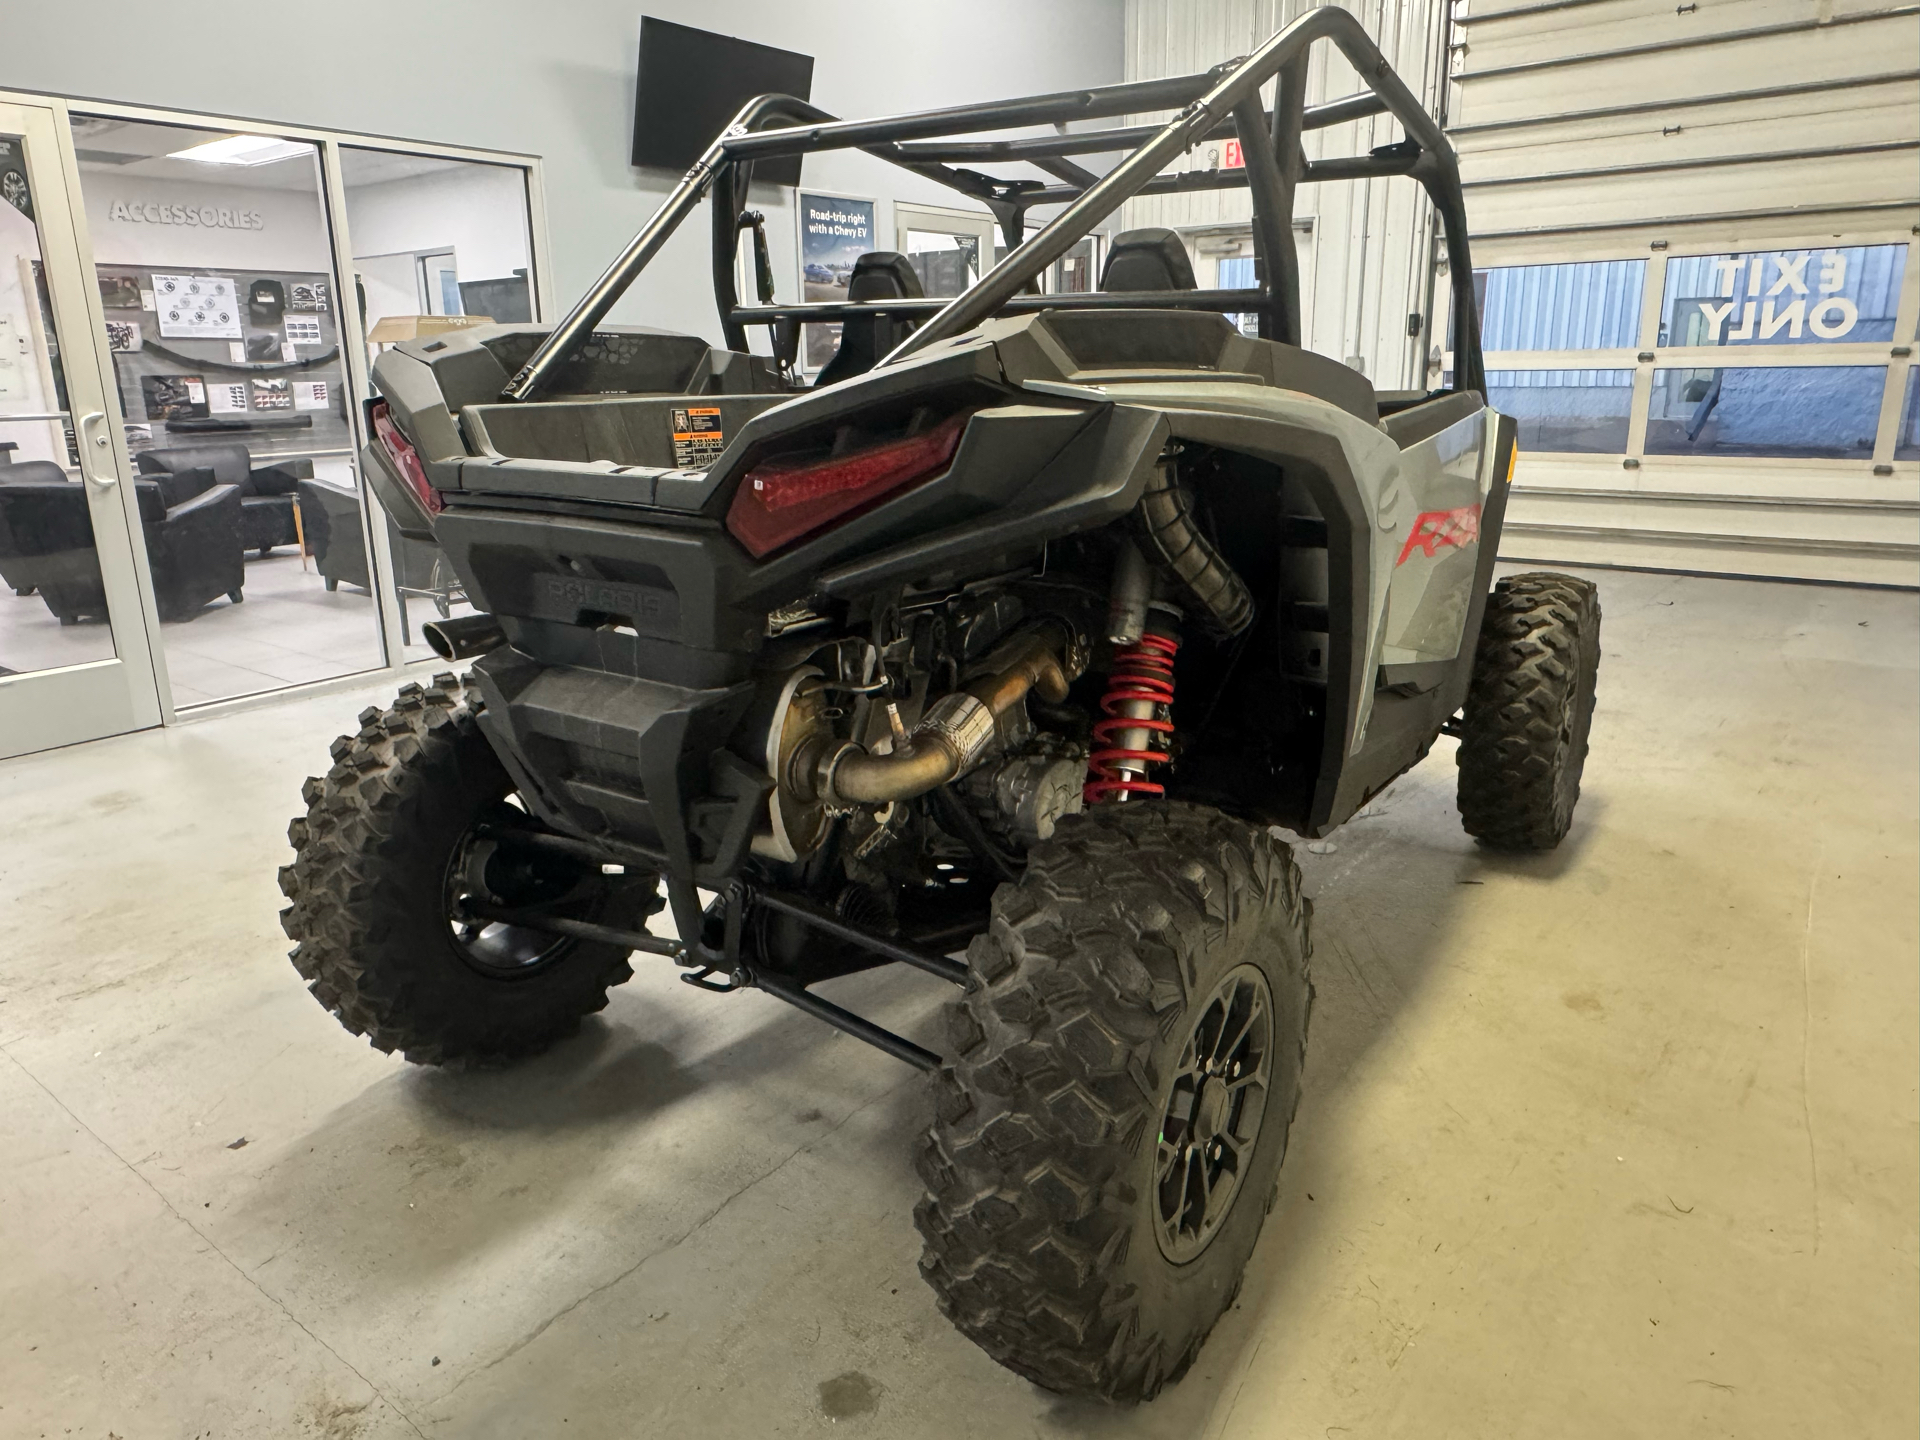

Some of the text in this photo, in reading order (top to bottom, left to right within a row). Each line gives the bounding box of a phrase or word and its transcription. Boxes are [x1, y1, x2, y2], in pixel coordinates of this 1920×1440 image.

[1226, 142, 1246, 167] EX
[110, 200, 264, 231] ACCESSORIES
[810, 209, 866, 226] Road-trip right
[809, 224, 827, 234] with
[834, 226, 857, 238] Chevy
[858, 228, 867, 238] EV
[548, 579, 660, 614] POLARIS
